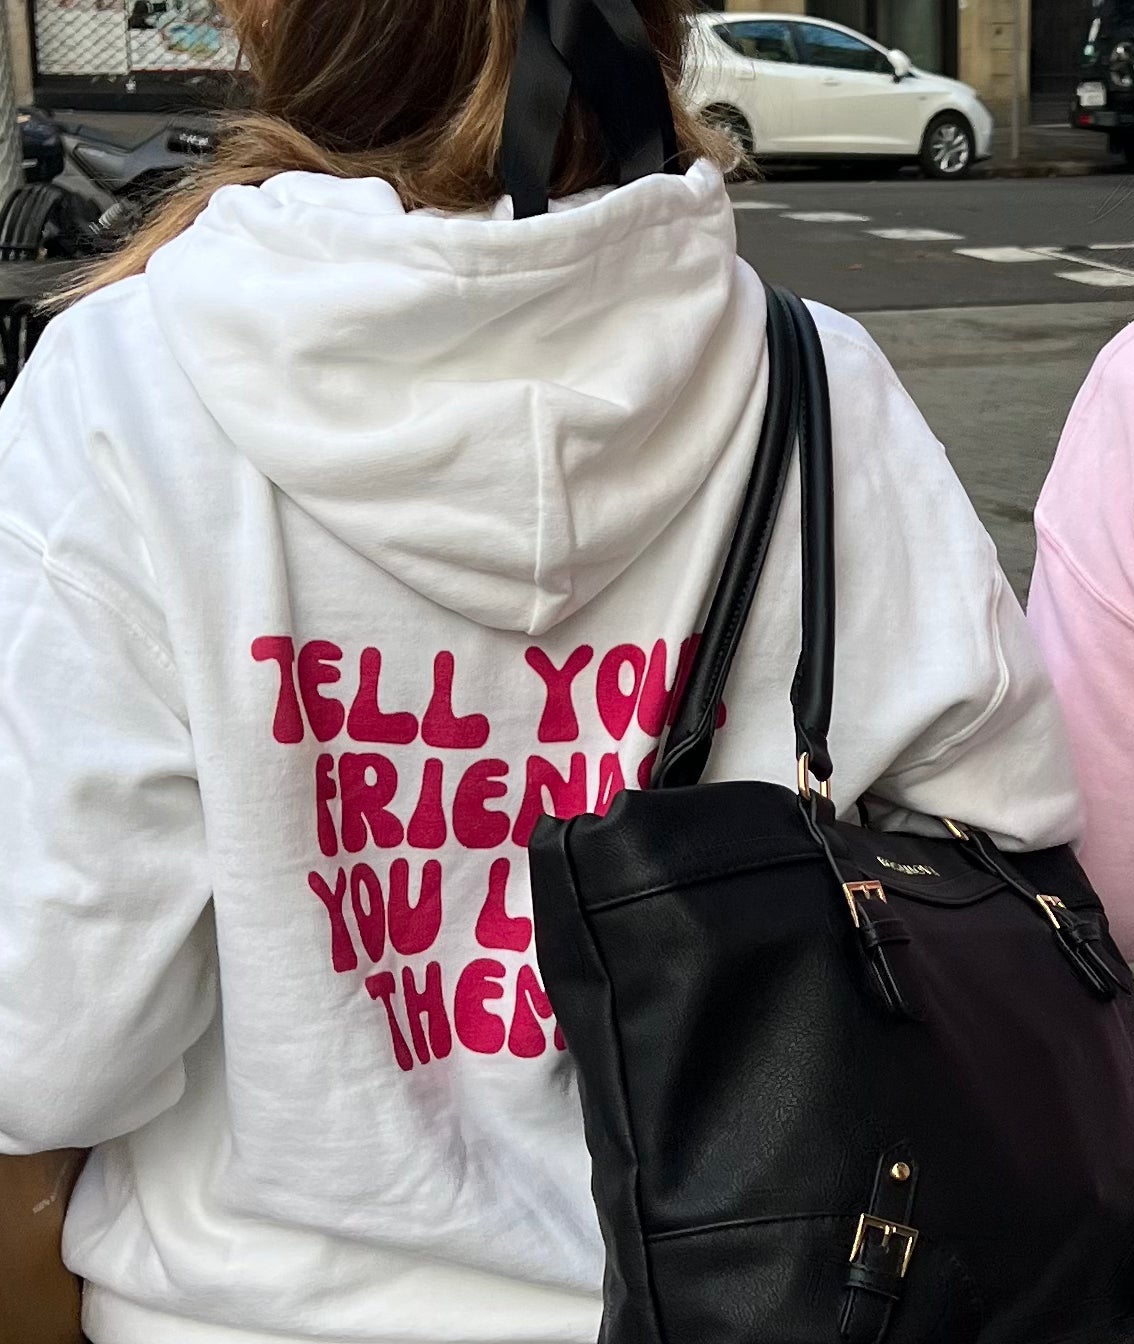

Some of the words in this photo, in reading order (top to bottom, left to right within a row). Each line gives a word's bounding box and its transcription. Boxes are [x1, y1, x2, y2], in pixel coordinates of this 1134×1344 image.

[251, 635, 489, 749] TELL
[525, 632, 727, 743] YOU
[308, 858, 442, 973] YOU
